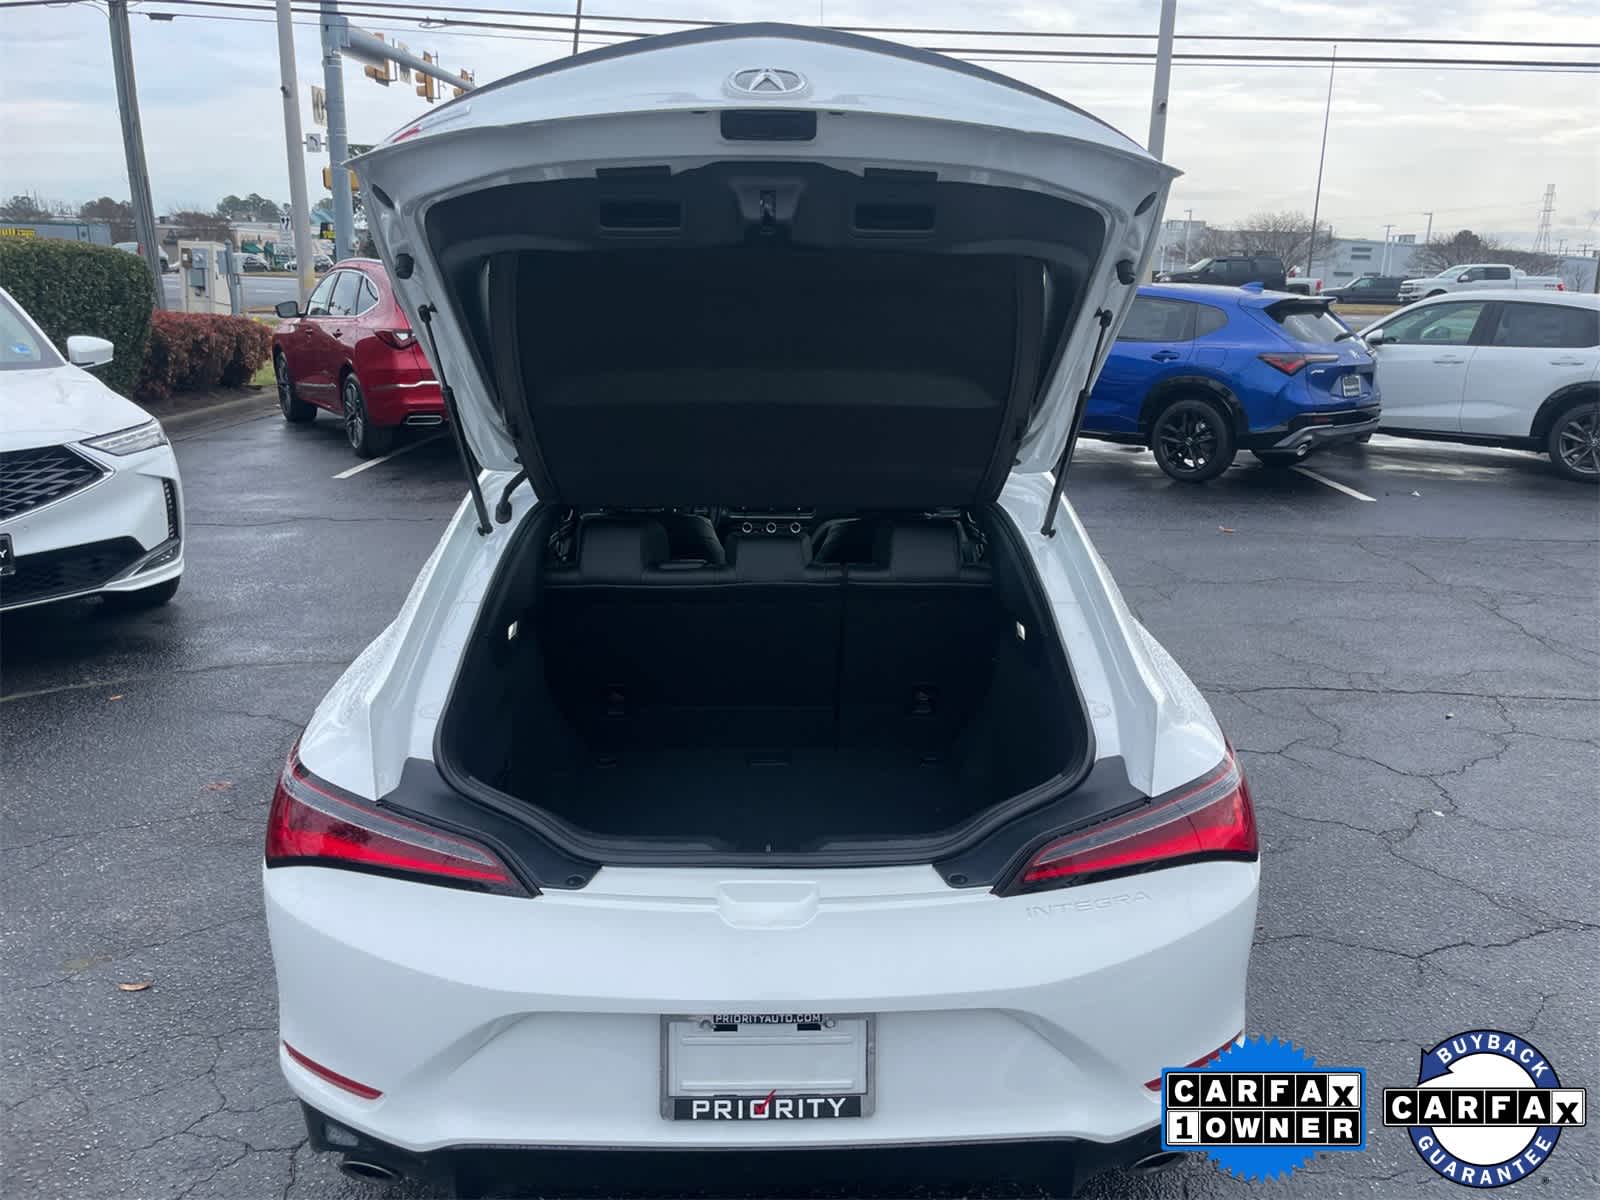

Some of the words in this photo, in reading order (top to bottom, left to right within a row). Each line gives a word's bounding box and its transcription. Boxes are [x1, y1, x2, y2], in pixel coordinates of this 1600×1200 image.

[1024, 890, 1152, 920] INTEGRA
[715, 1013, 823, 1025] PRIORITYAUTO.COM
[692, 1098, 847, 1121] PRIORITY
